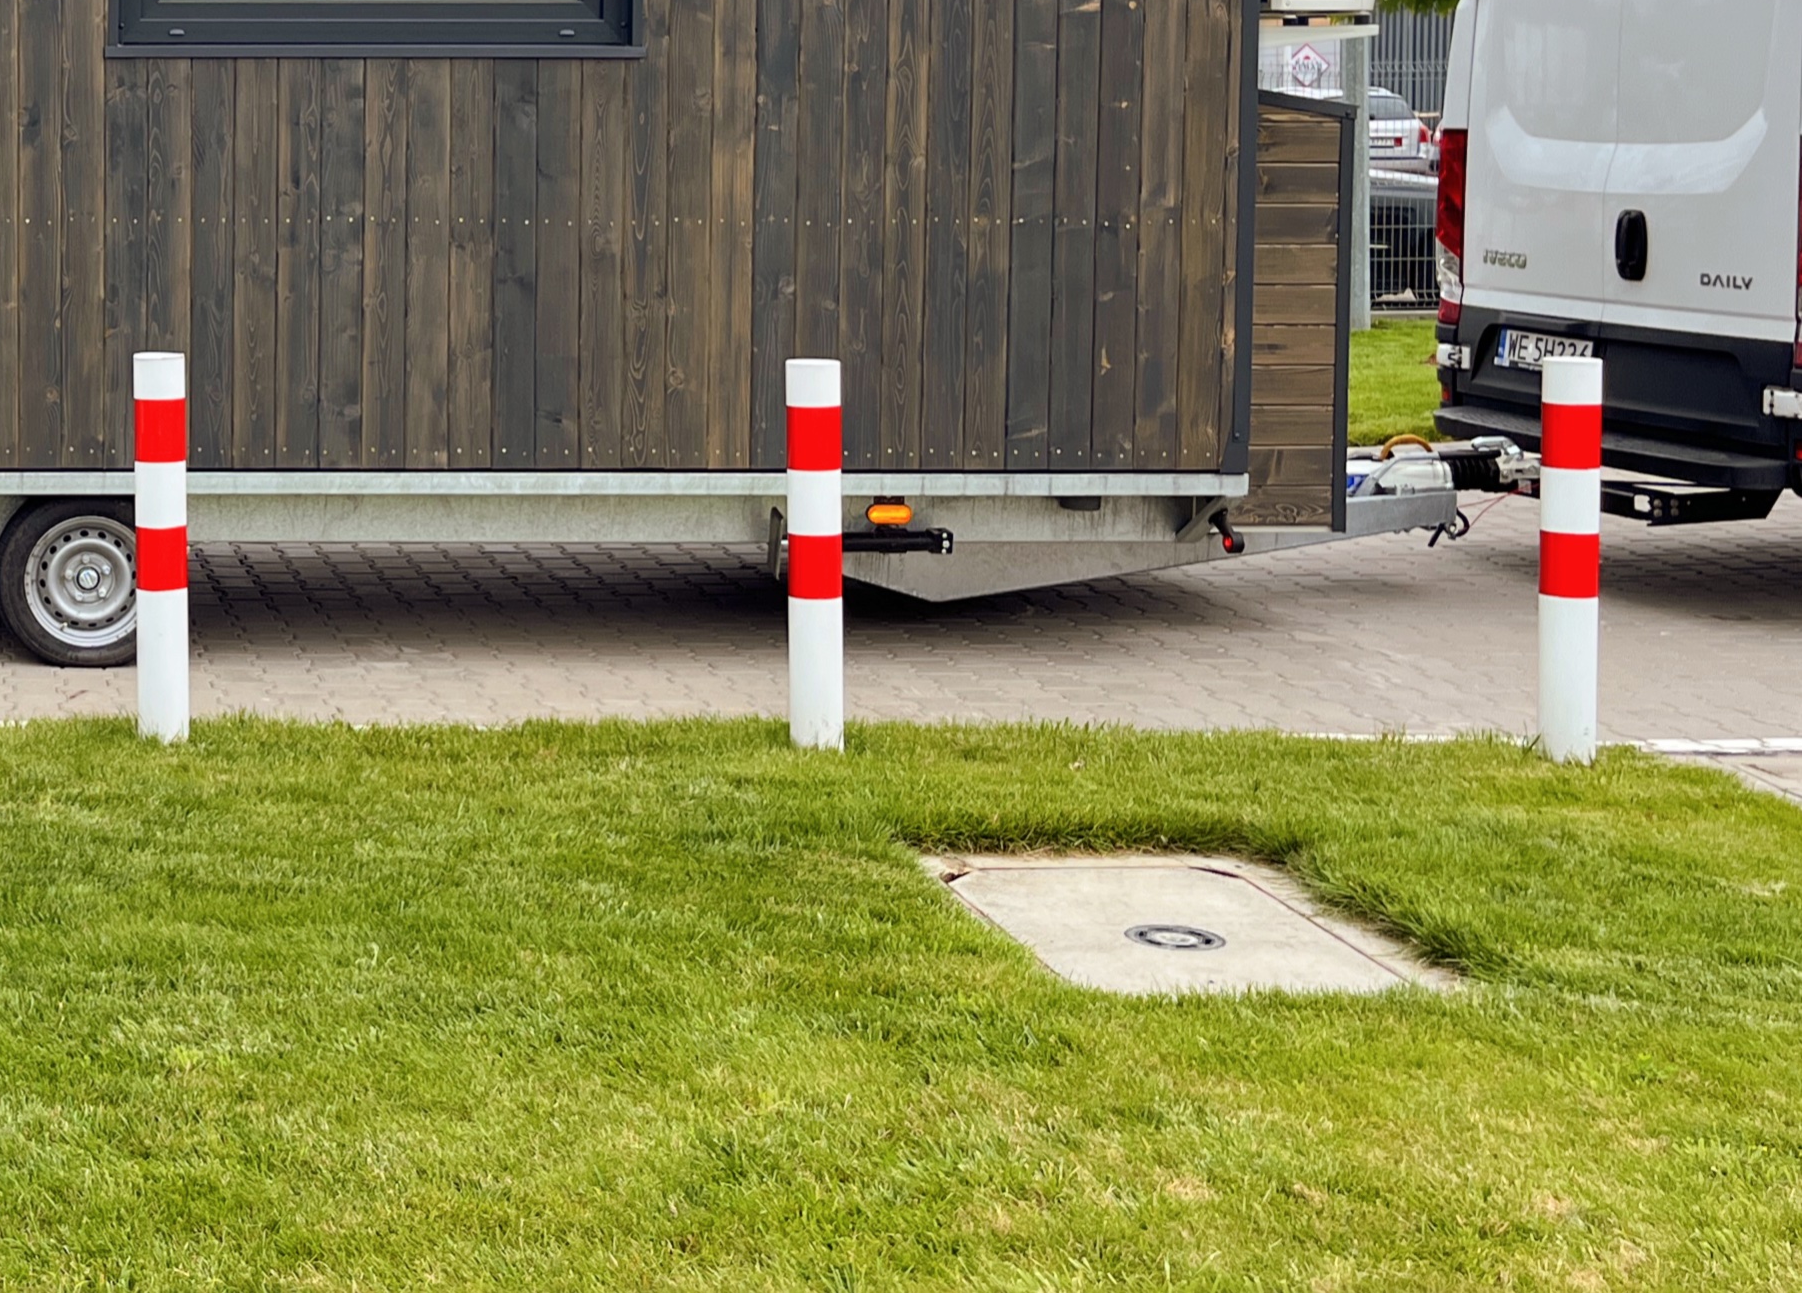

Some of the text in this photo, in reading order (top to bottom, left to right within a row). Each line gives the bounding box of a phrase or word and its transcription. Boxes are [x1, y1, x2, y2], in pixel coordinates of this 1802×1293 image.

[1483, 249, 1527, 269] IVECO
[1700, 273, 1753, 290] DAILY
[1508, 333, 1529, 361] WE
